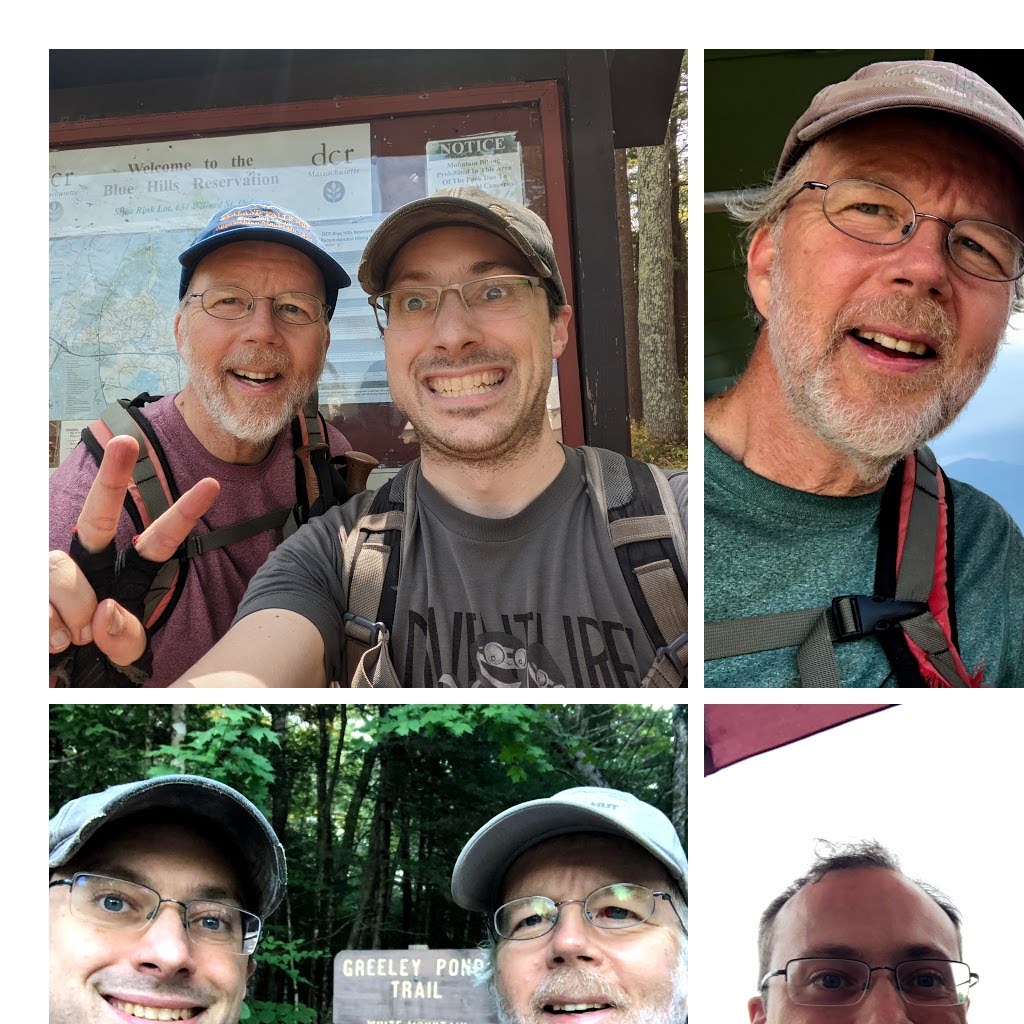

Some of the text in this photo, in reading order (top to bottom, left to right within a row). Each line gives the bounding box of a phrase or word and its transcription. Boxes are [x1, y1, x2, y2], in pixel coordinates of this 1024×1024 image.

[311, 143, 355, 166] dcr
[440, 137, 506, 155] NOTICE
[128, 155, 254, 174] Welcome to the
[308, 167, 360, 178] Massachusetts
[447, 160, 478, 168] Mountain
[49, 171, 74, 188] cr
[103, 173, 280, 197] Blue Hills Reservation
[135, 206, 155, 214] Rink
[343, 959, 421, 977] GREELEY
[391, 980, 443, 999] TRAIL
